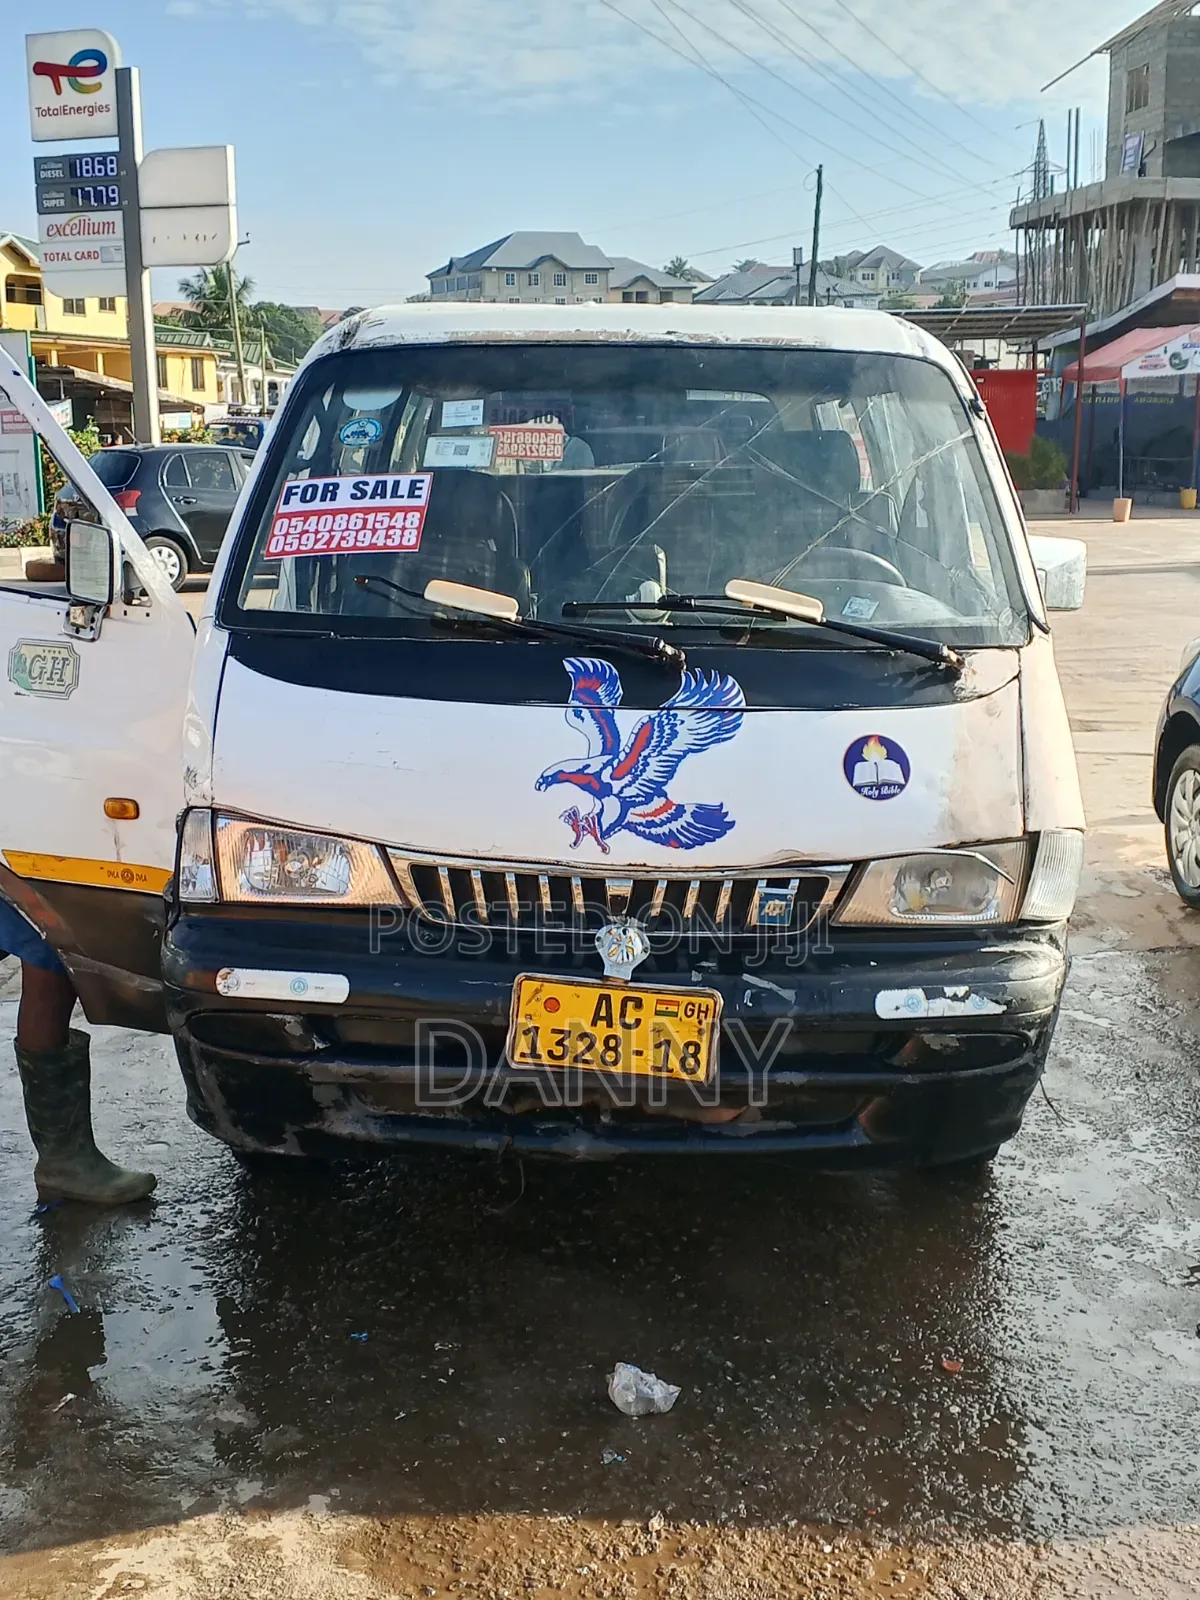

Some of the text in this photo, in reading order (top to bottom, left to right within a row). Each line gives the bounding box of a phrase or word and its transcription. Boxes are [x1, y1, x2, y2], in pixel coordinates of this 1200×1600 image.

[35, 102, 110, 117] TotalEnergies
[40, 169, 64, 178] DIESEL
[76, 156, 117, 177] 18.68
[43, 199, 65, 207] SUPER
[77, 185, 119, 206] 17.79
[46, 218, 116, 238] excellium
[44, 250, 99, 262] TOTAL CARD
[282, 479, 425, 505] FOR SALE
[273, 511, 421, 536] 0540861548
[269, 528, 418, 553] 0592739438
[28, 654, 70, 685] GH
[861, 785, 901, 798] Holy Bible
[590, 993, 710, 1030] AC GH
